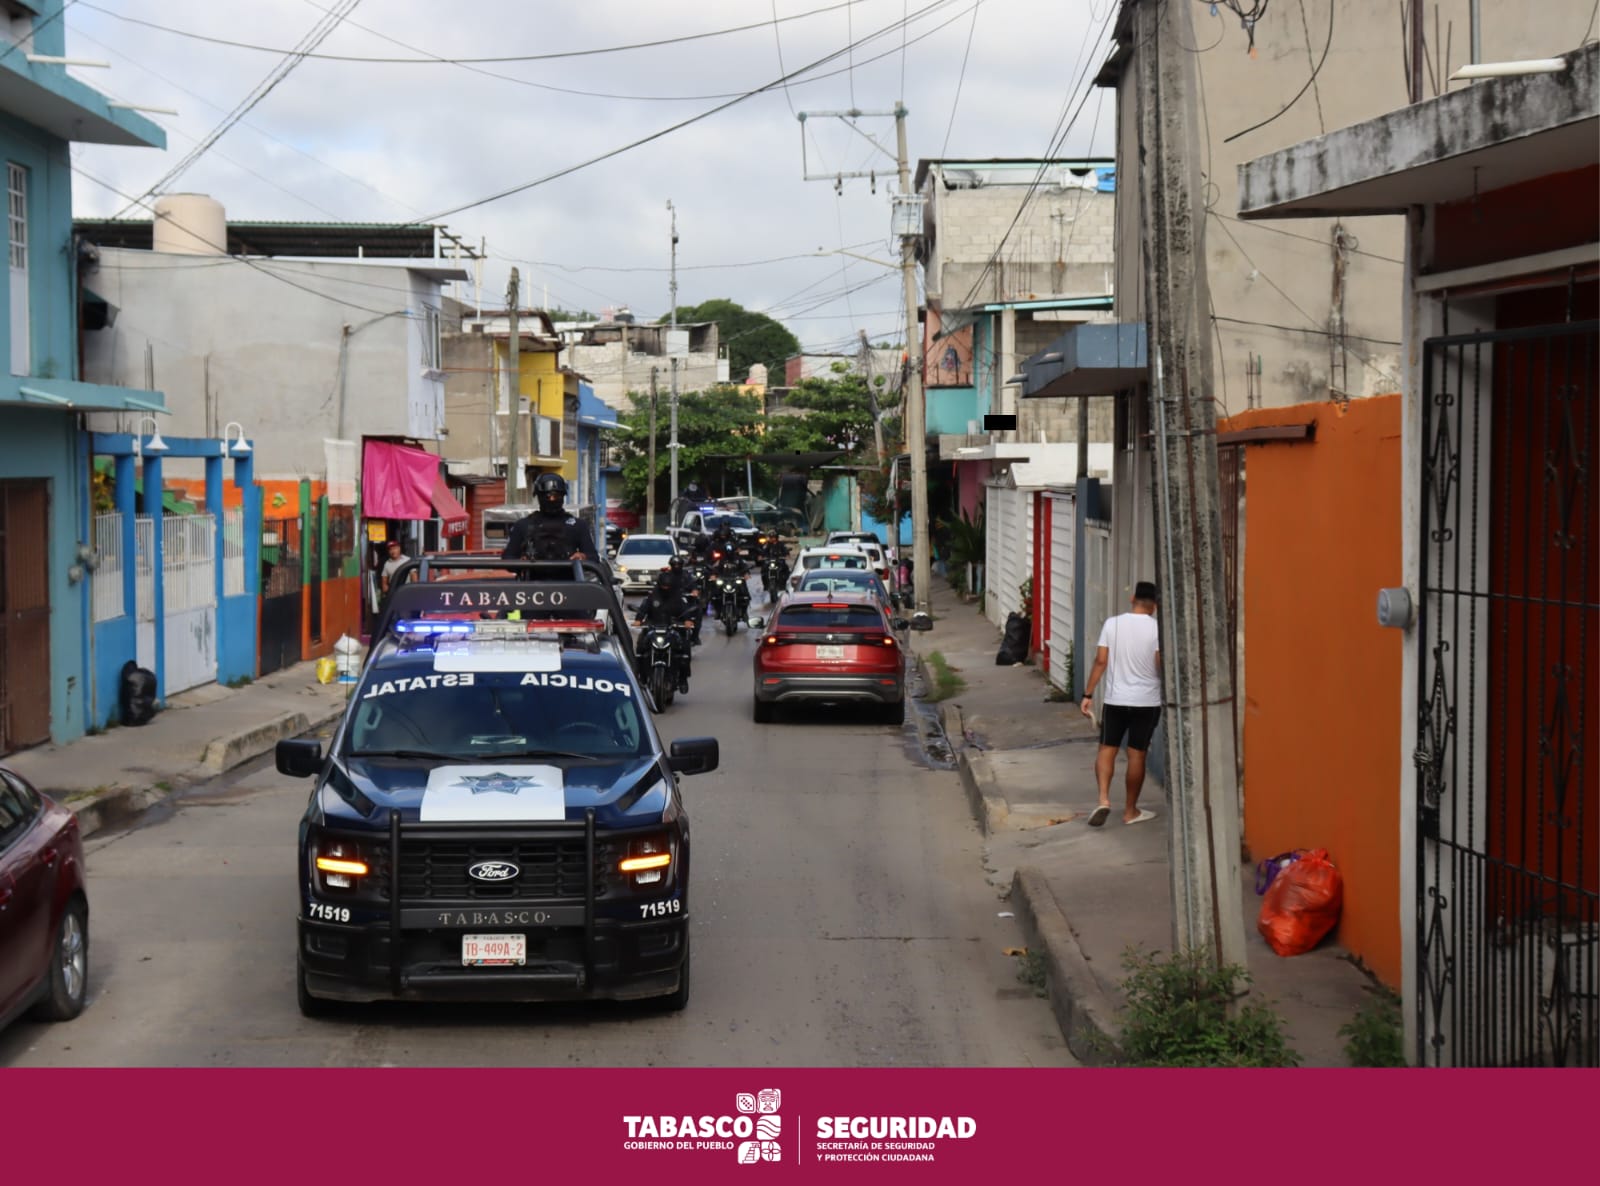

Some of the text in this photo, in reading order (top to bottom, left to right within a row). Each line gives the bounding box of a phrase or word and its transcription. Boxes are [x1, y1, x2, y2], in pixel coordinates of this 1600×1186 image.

[478, 864, 509, 878] Ford
[309, 904, 350, 922] 71519
[640, 900, 680, 917] 71519
[465, 942, 523, 956] TB-449A-2
